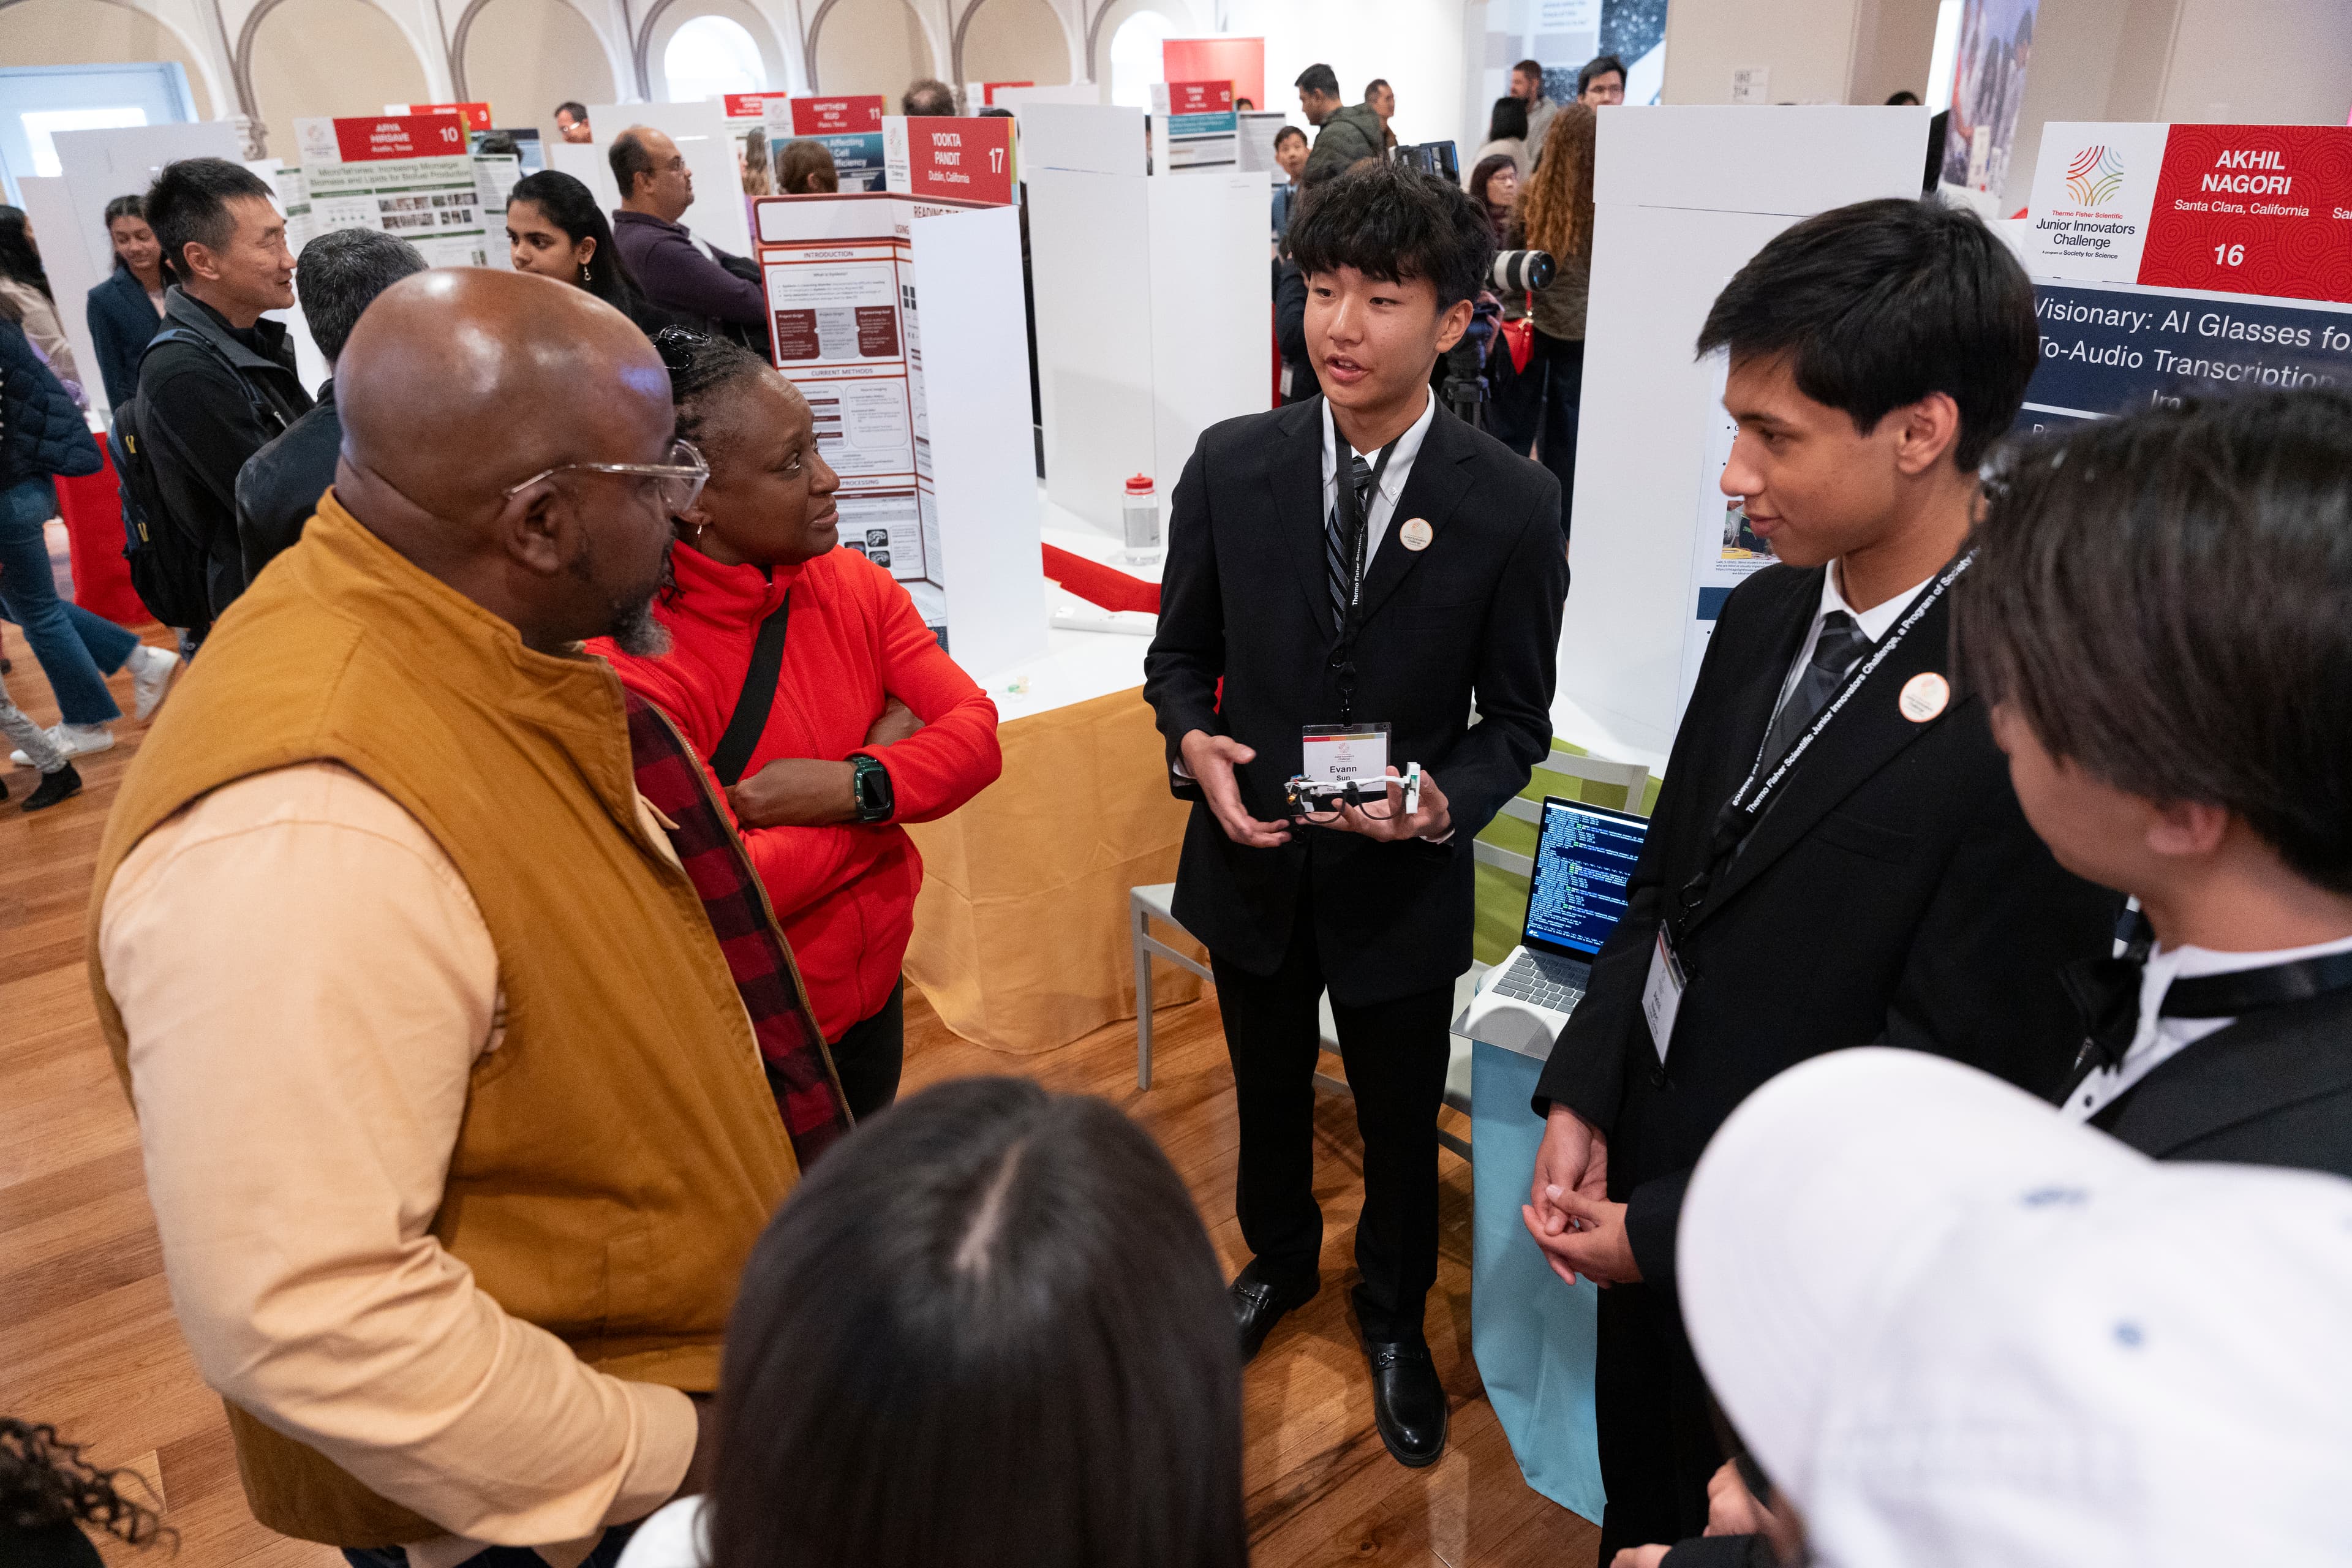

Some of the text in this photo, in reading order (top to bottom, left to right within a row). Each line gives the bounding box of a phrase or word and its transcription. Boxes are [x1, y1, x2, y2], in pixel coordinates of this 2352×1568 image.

[813, 102, 848, 111] MATTHEW
[869, 107, 880, 121] 11
[440, 127, 458, 143] 10
[829, 138, 864, 148] Affecting
[932, 133, 962, 147] YOOKTA
[833, 159, 867, 168] fficiency
[934, 151, 961, 165] PANDIT
[989, 148, 1005, 174] 17
[2215, 150, 2286, 170] AKHIL
[929, 170, 970, 184] Dublin, California
[2201, 173, 2292, 195] NAGORI
[2174, 199, 2309, 217] Santa Clara, California
[2332, 207, 2352, 219] Sa
[895, 224, 909, 235] USING
[2036, 218, 2136, 235] Junior Innovators
[2054, 233, 2111, 250] Challenge
[804, 251, 854, 259] INTRODUCTION
[2214, 244, 2245, 266] 16
[2034, 296, 2352, 352] Visionary: AI Glasses fo
[2038, 336, 2144, 369] To-Audio
[1940, 556, 1973, 586] Society
[1933, 583, 1945, 596] of
[1901, 594, 1937, 630] Program
[1898, 627, 1907, 636] a
[1862, 636, 1902, 674] Challenge,
[1830, 673, 1867, 713] Innovators
[1812, 710, 1833, 735] Junior
[1784, 733, 1814, 767] Scientific
[1766, 764, 1787, 788] Fisher
[1746, 786, 1770, 813] Thermo
